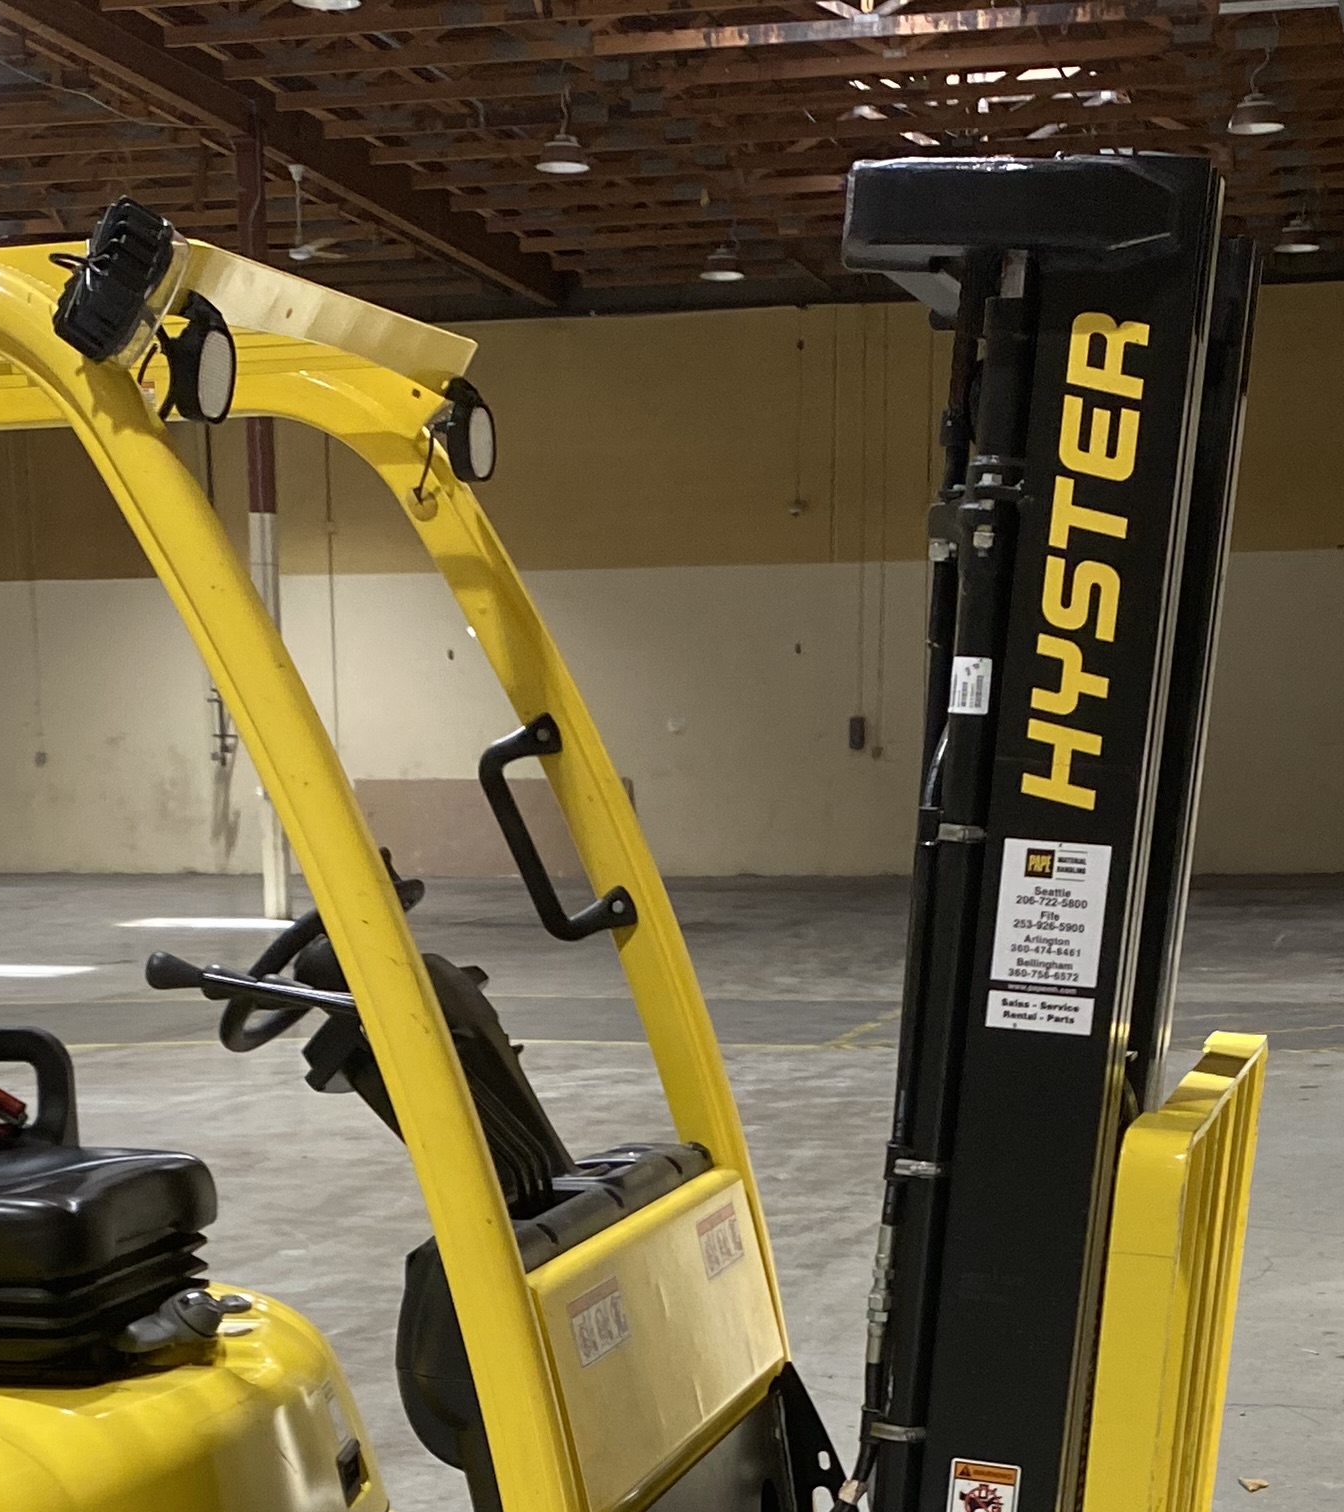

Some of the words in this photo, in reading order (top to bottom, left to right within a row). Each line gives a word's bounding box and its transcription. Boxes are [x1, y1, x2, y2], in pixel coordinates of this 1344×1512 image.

[1020, 311, 1150, 811] HYSTER
[1034, 886, 1072, 898] Seattle
[1015, 895, 1089, 909] 206-722-5800
[1040, 911, 1060, 921] Fife
[1012, 919, 1085, 933] 253-926-5900
[1023, 934, 1071, 947] Arlington
[1016, 957, 1074, 970] Bellingham
[1001, 998, 1030, 1008] Sales
[1040, 1001, 1080, 1012] Service
[1003, 1010, 1038, 1021] Rental
[1047, 1014, 1075, 1024] Parts
